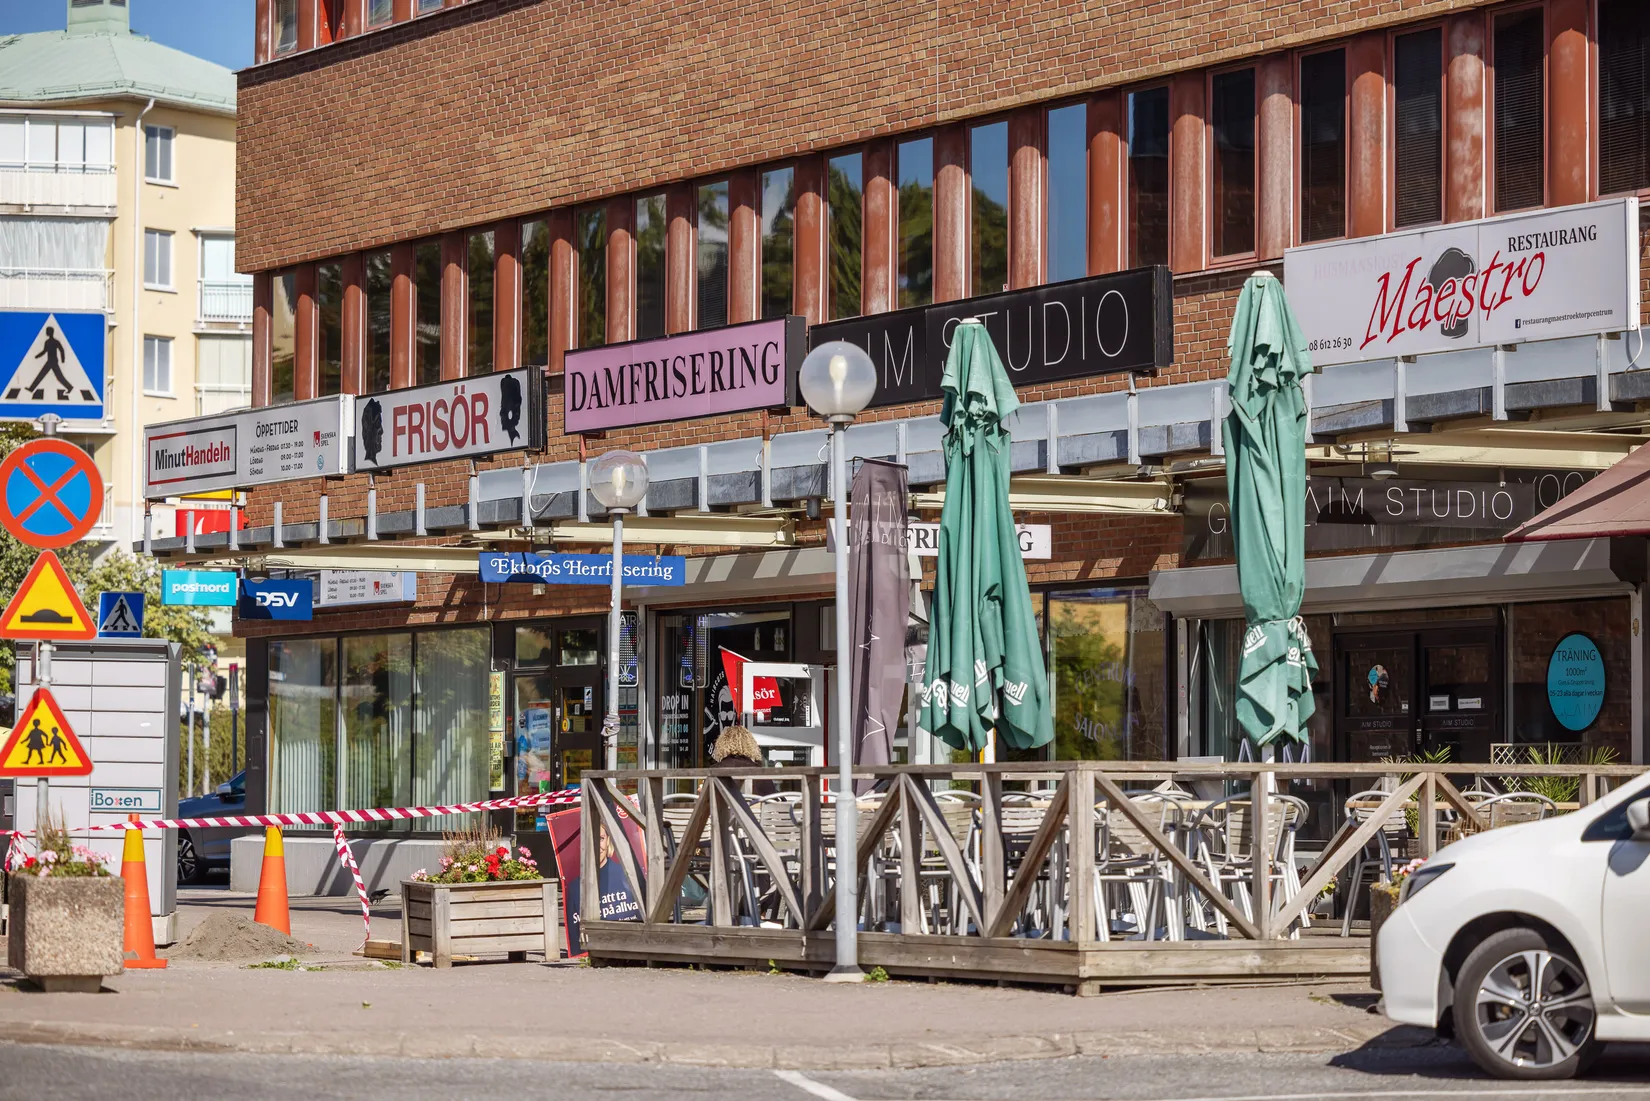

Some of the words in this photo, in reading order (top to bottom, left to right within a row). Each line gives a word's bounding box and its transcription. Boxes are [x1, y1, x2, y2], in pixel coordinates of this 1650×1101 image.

[1508, 225, 1597, 253] RESTAURANG
[1360, 251, 1546, 350] Maestro
[1522, 309, 1613, 325] restaurangmaestroektorpcentrum
[1308, 340, 1318, 351] 08
[1320, 338, 1331, 350] 612
[1333, 337, 1341, 348] 26
[1343, 337, 1352, 349] 30
[570, 341, 781, 412] DAMFRISERING
[256, 420, 299, 438] ÖPPETTIDER
[392, 385, 490, 457] FRISÖR
[155, 441, 231, 470] MinutHandeln
[1304, 486, 1364, 515] AIM
[1386, 487, 1513, 520] STUDIO
[490, 558, 560, 578] Ektorps
[563, 560, 674, 580] Herrfsering
[172, 582, 229, 594] postnord
[256, 592, 299, 607] DSV
[620, 615, 637, 625] AIR
[1556, 648, 1596, 662] TRÄNING
[753, 688, 775, 700] sör
[662, 695, 680, 710] DROP
[681, 695, 689, 710] IN
[602, 893, 615, 904] att
[616, 891, 627, 901] ta
[602, 904, 615, 918] på
[616, 901, 639, 913] allva
